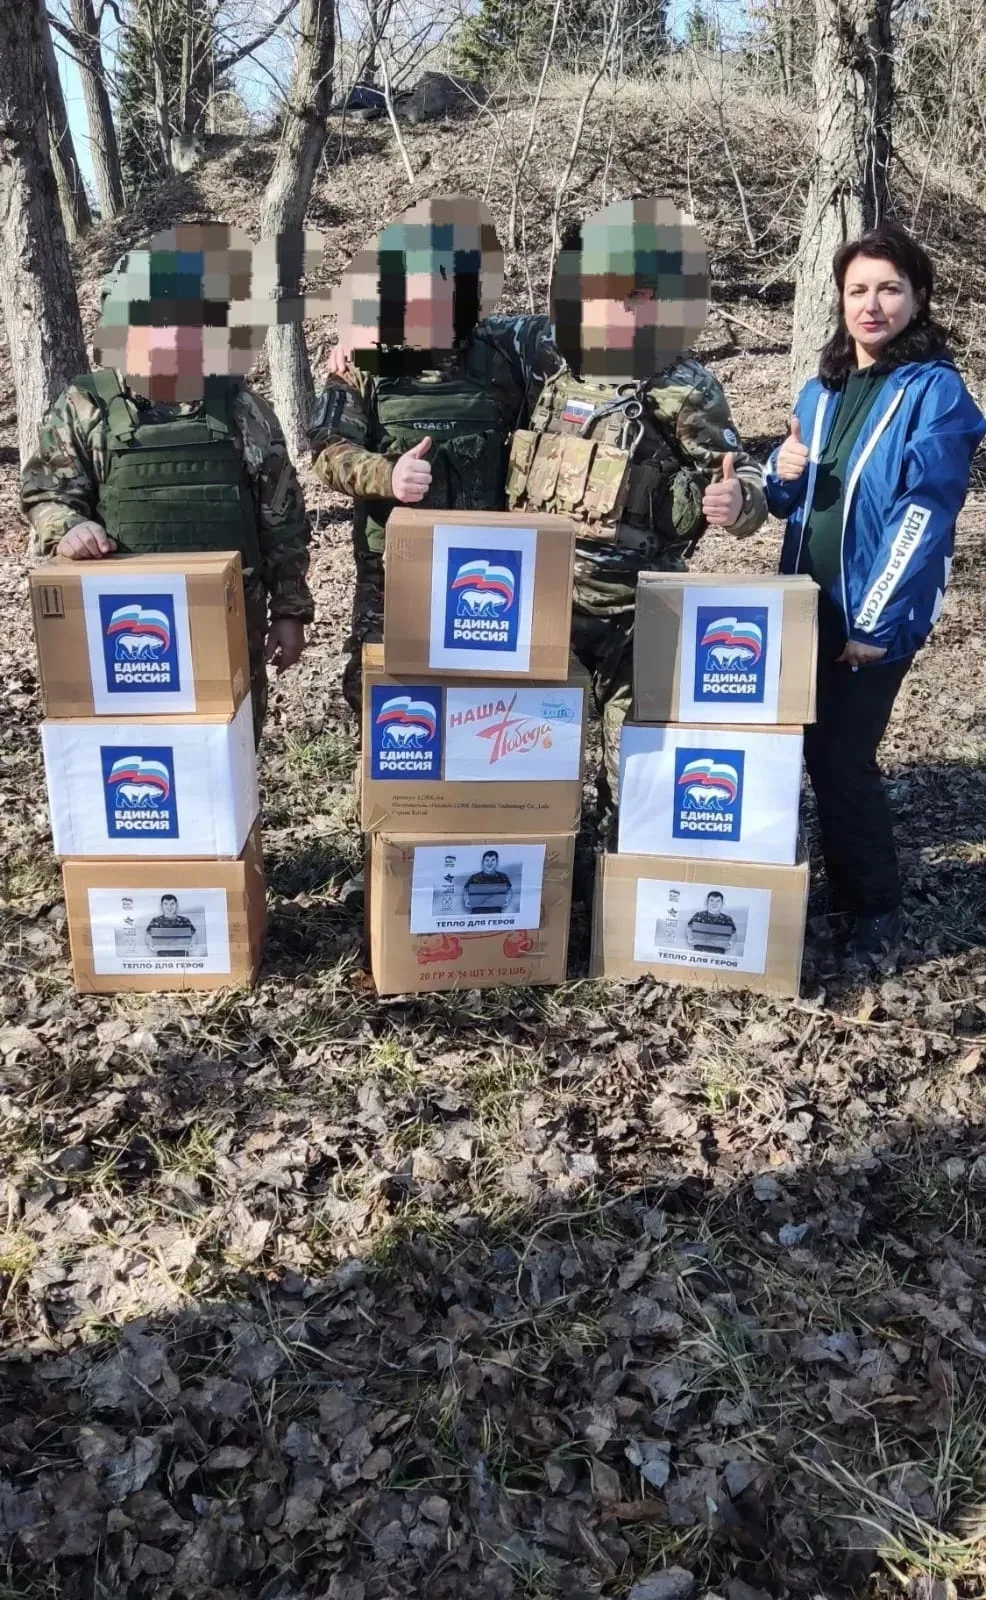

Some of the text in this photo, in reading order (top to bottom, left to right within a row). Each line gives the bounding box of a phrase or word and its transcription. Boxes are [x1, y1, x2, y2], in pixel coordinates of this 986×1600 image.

[858, 510, 925, 627] ЕДИНАЯ РОССИЯ
[454, 618, 510, 630] ЕДИНАЯ
[453, 630, 508, 642] РОССИЯ
[114, 662, 171, 673] ЕДИНАЯ
[115, 673, 171, 683] РОССИЯ
[703, 673, 757, 683] ЕДИНАЯ
[702, 683, 757, 694] РОССИЯ
[450, 699, 506, 728] НАША
[379, 750, 433, 761] ЕДИНАЯ
[380, 761, 432, 771] РОССИЯ
[114, 810, 169, 820] ЕДИНАЯ
[680, 811, 733, 822] ЕДИНАЯ
[115, 820, 170, 830] РОССИЯ
[680, 821, 733, 832] РОССИЯ
[436, 918, 515, 928] ТЕПЛО ДЛЯ ГЕРОЯ
[658, 951, 738, 967] ТЕПЛО ДЛЯ ГЕРОЯ
